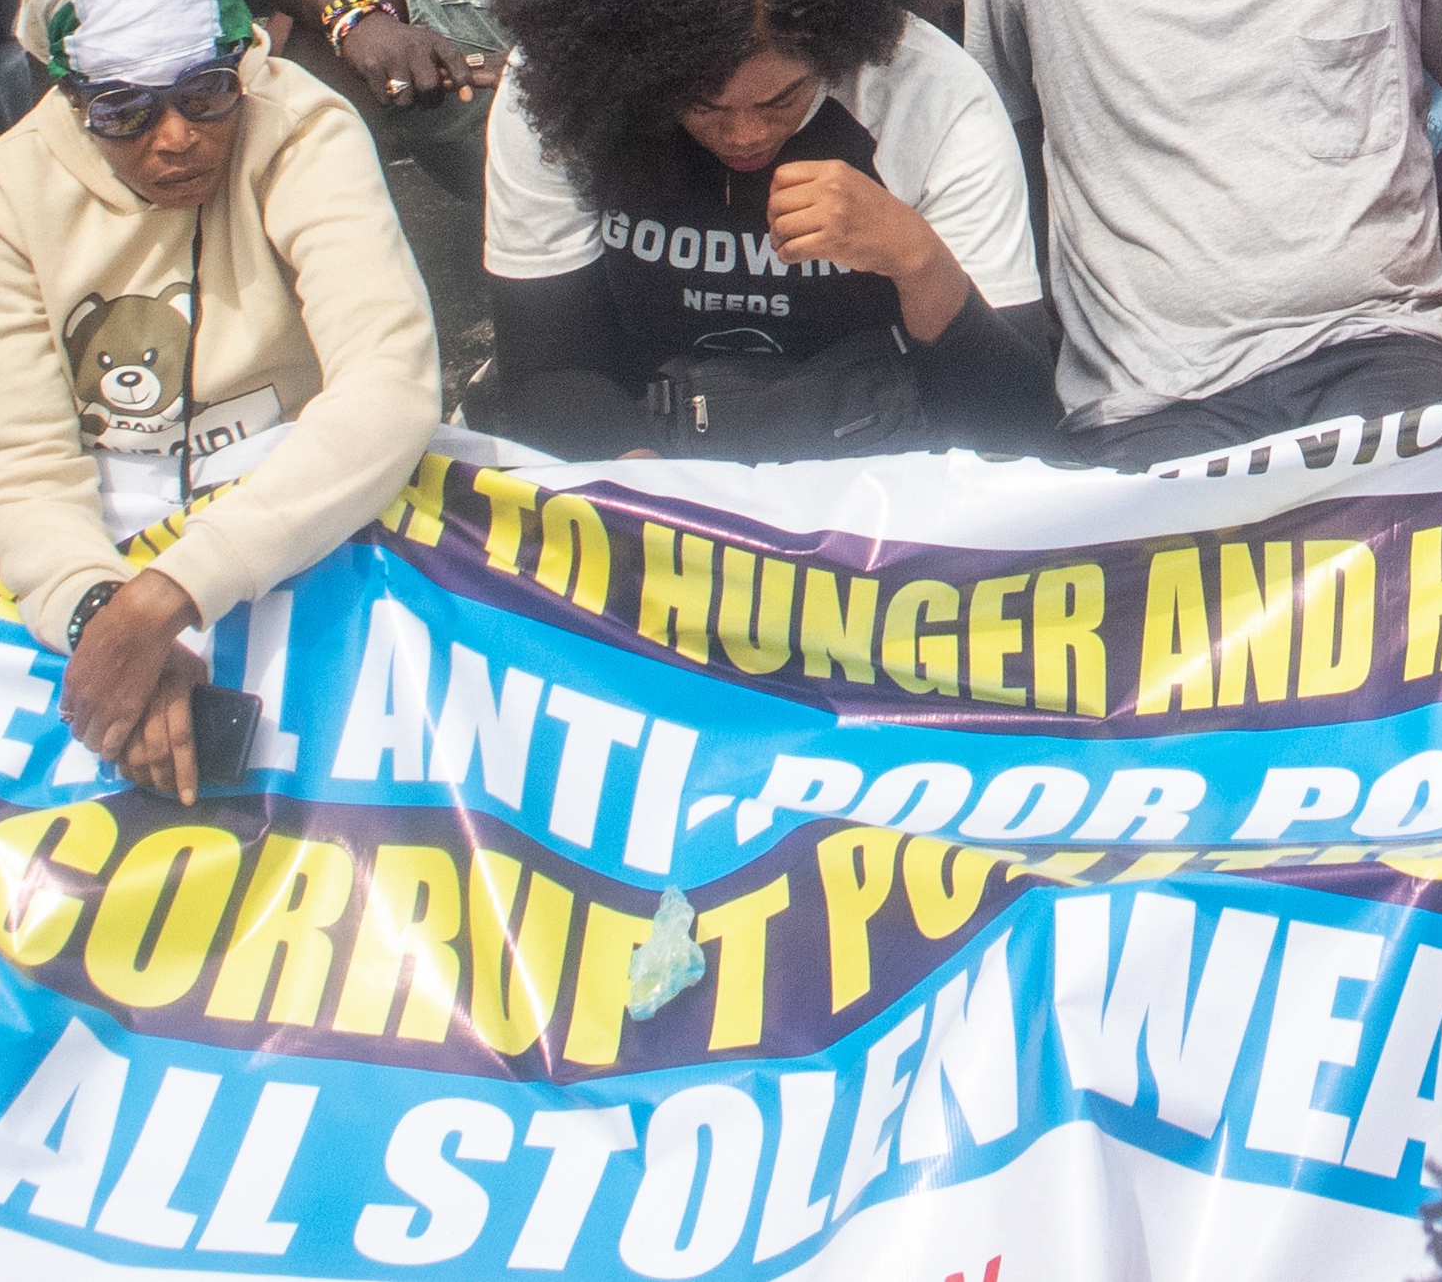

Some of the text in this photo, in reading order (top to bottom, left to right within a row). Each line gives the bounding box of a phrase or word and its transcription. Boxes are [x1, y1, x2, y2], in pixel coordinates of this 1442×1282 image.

[682, 286, 791, 318] NEEDS
[472, 471, 615, 616] TO
[637, 517, 1109, 719] HUNGER
[1134, 535, 1376, 717] AND
[354, 928, 1018, 1282] STOLEN
